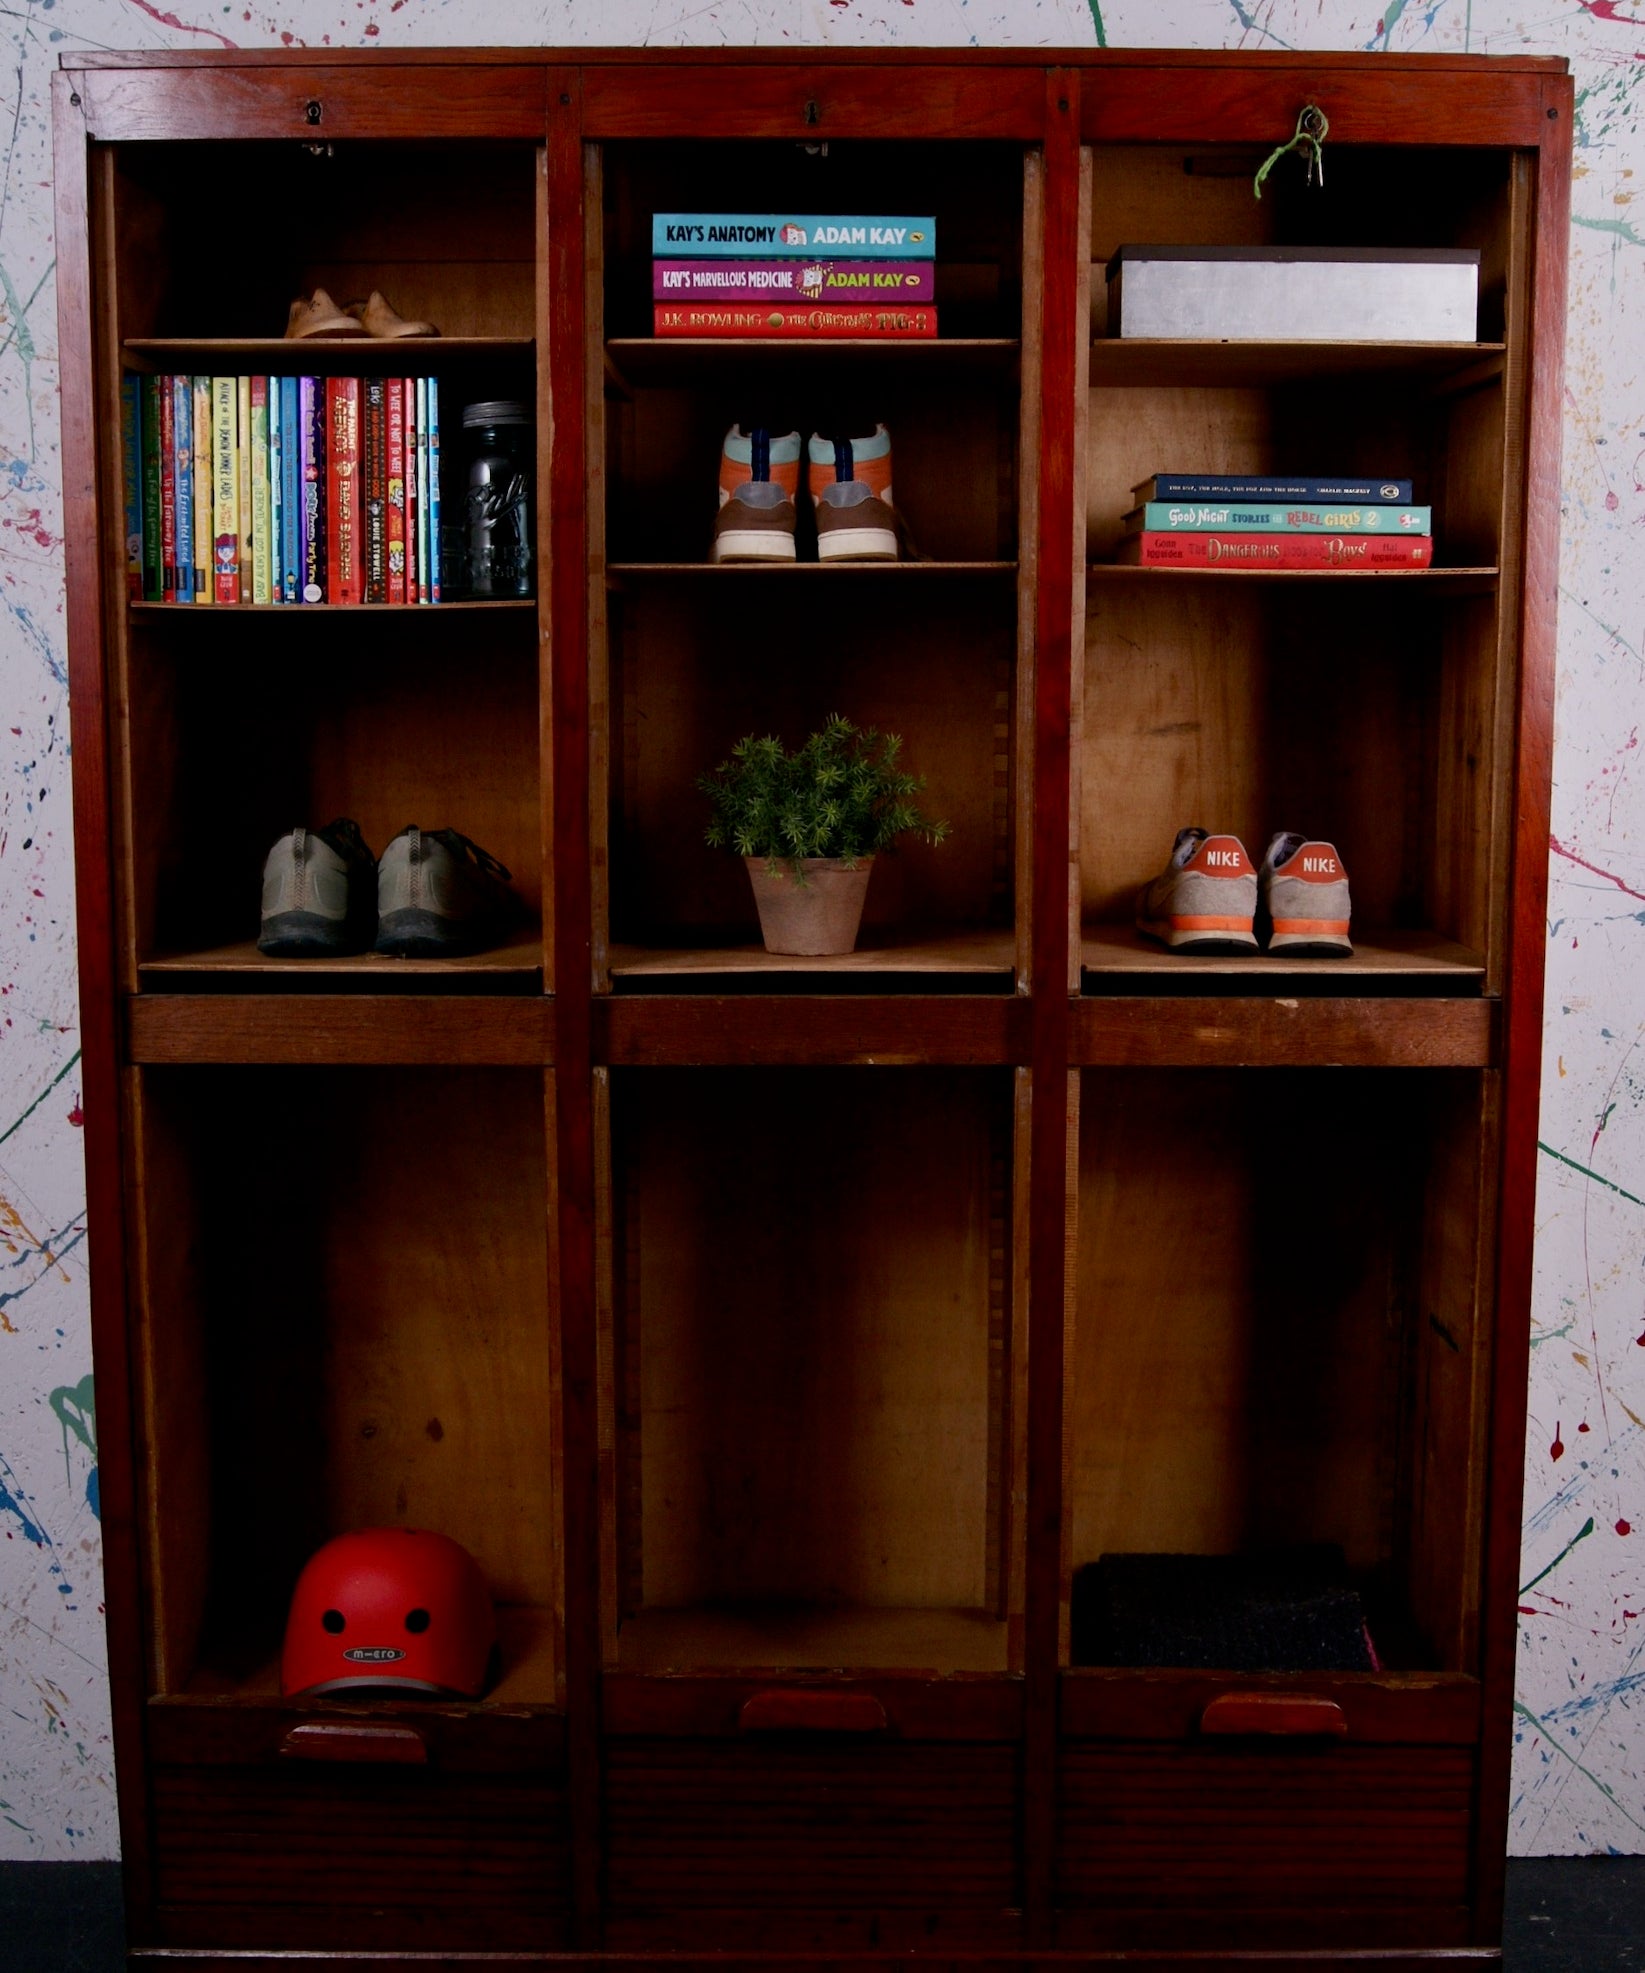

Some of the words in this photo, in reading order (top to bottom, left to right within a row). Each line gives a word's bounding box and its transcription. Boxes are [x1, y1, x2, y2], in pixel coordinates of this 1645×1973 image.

[667, 225, 704, 241] KAY'S
[708, 226, 776, 242] ANATOMY
[813, 227, 866, 244] ADAM
[870, 228, 907, 244] KAY
[663, 271, 690, 287] KAY'S
[693, 272, 747, 287] MARVELLOUS
[748, 271, 793, 287] MEDICINE
[826, 273, 870, 287] ADAM
[873, 273, 904, 287] KAY
[662, 313, 687, 326] J.K.
[690, 313, 762, 327] ROWLING
[786, 314, 807, 326] THE
[809, 311, 872, 330] CHRISTMAS
[876, 313, 914, 330] PIG
[219, 382, 231, 405] ATTACK
[347, 400, 356, 417] THE
[390, 395, 402, 412] WEE
[334, 396, 347, 454] AGENCY
[390, 413, 401, 426] OR
[219, 429, 231, 451] DEMON
[347, 418, 356, 450] PARENT
[390, 427, 402, 443] NOT
[219, 477, 232, 500] LADIES
[1231, 513, 1270, 523] STORIES
[1287, 511, 1323, 528] REBEL
[1367, 511, 1376, 525] 2
[372, 517, 381, 541] LOUIE
[255, 538, 265, 552] GOT
[306, 541, 317, 564] Party
[371, 543, 381, 581] STOWELL
[308, 564, 316, 584] Time
[255, 580, 266, 599] BABY
[1207, 851, 1240, 867] NIKE
[1303, 857, 1336, 873] NIKE
